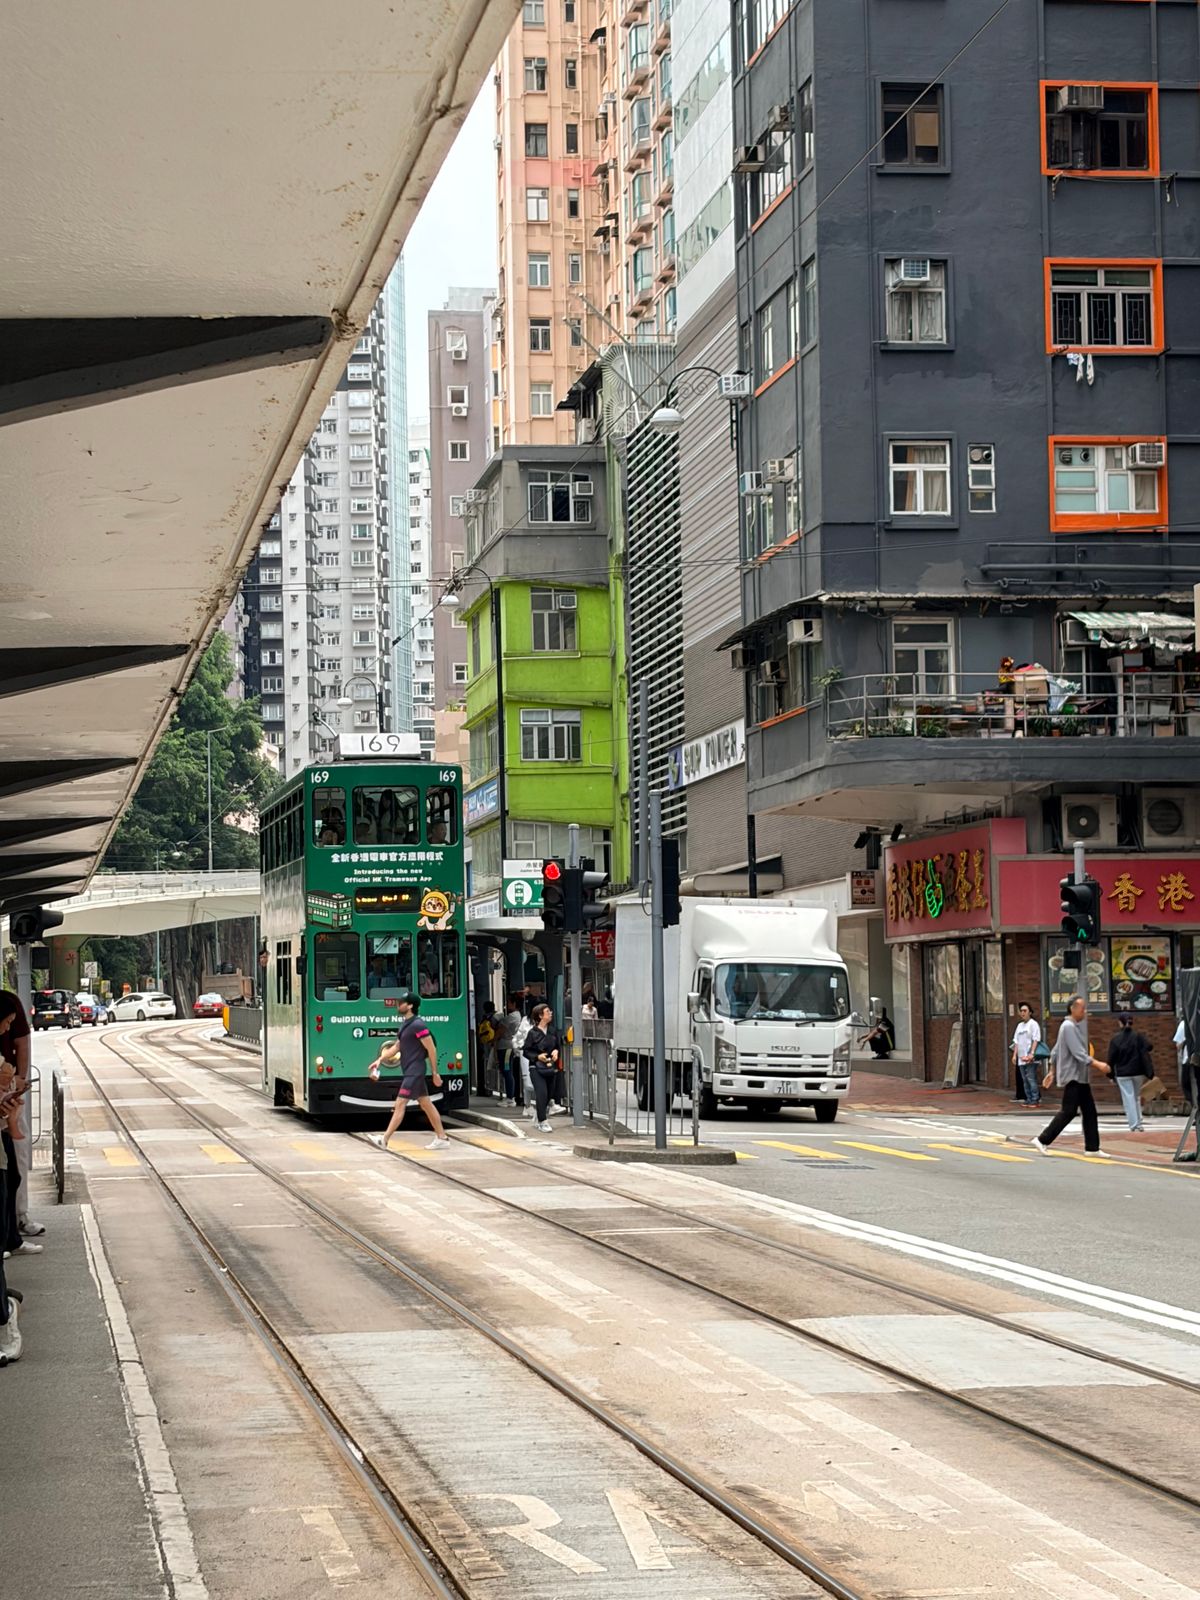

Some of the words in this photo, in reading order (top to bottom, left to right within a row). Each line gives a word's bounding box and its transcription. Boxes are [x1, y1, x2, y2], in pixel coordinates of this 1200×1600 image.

[360, 735, 400, 752] 169
[311, 771, 330, 783] 169
[439, 770, 457, 782] 169
[369, 1015, 389, 1023] Your
[448, 1079, 463, 1091] 169
